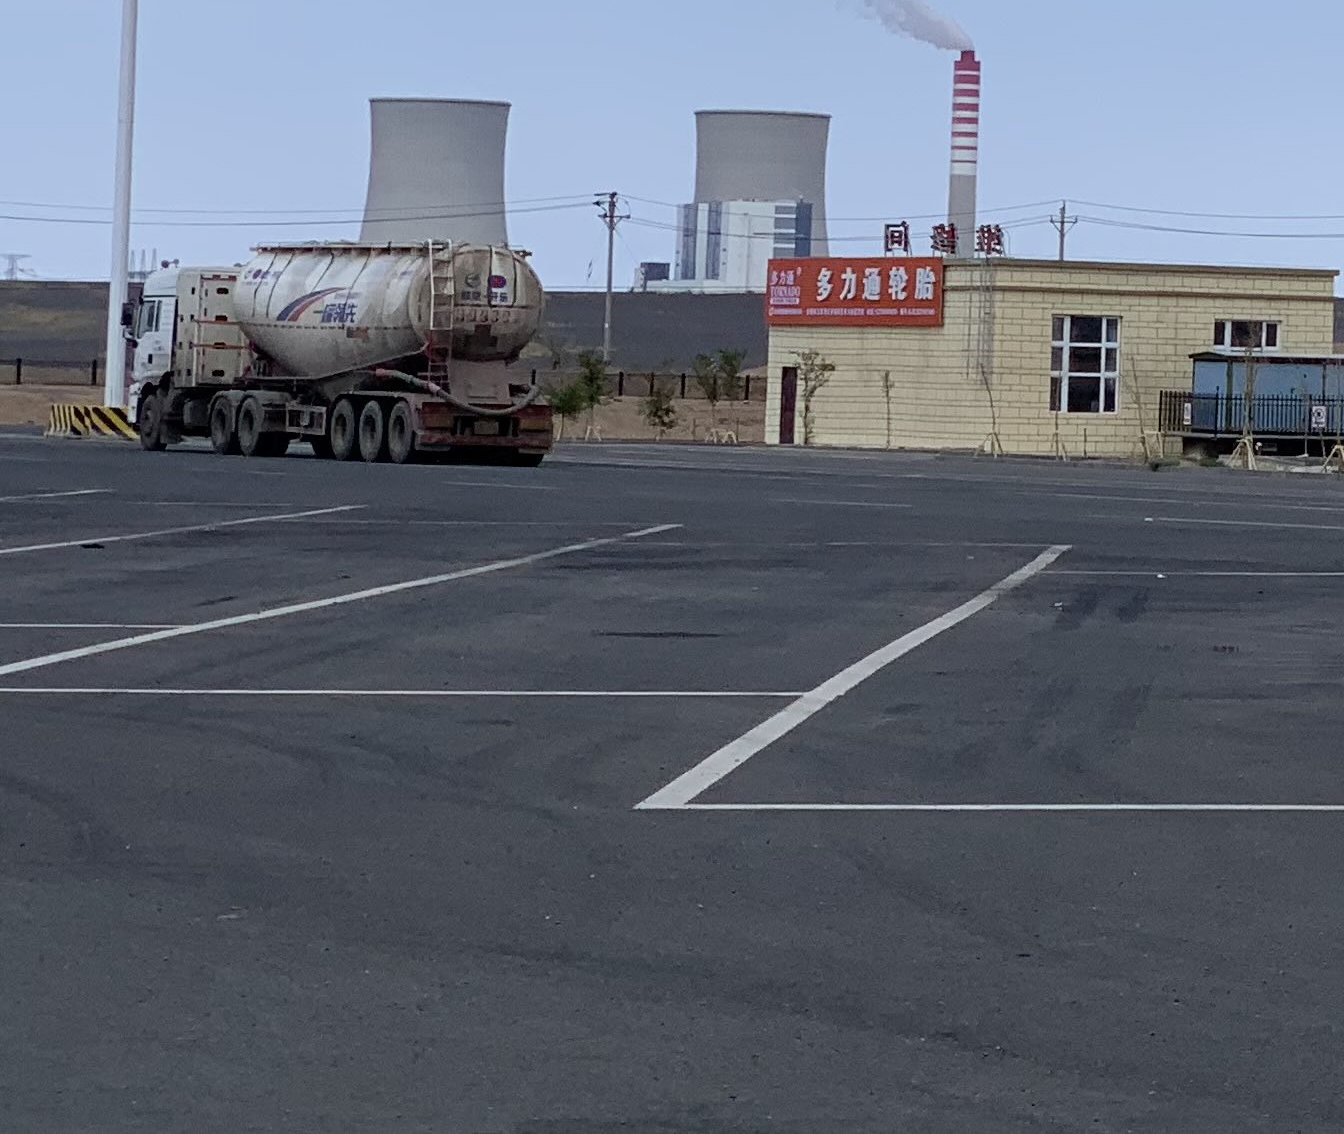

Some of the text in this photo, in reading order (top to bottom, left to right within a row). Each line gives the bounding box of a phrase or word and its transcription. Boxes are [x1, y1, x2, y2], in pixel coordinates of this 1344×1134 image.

[816, 266, 936, 302] 多力通轮胎
